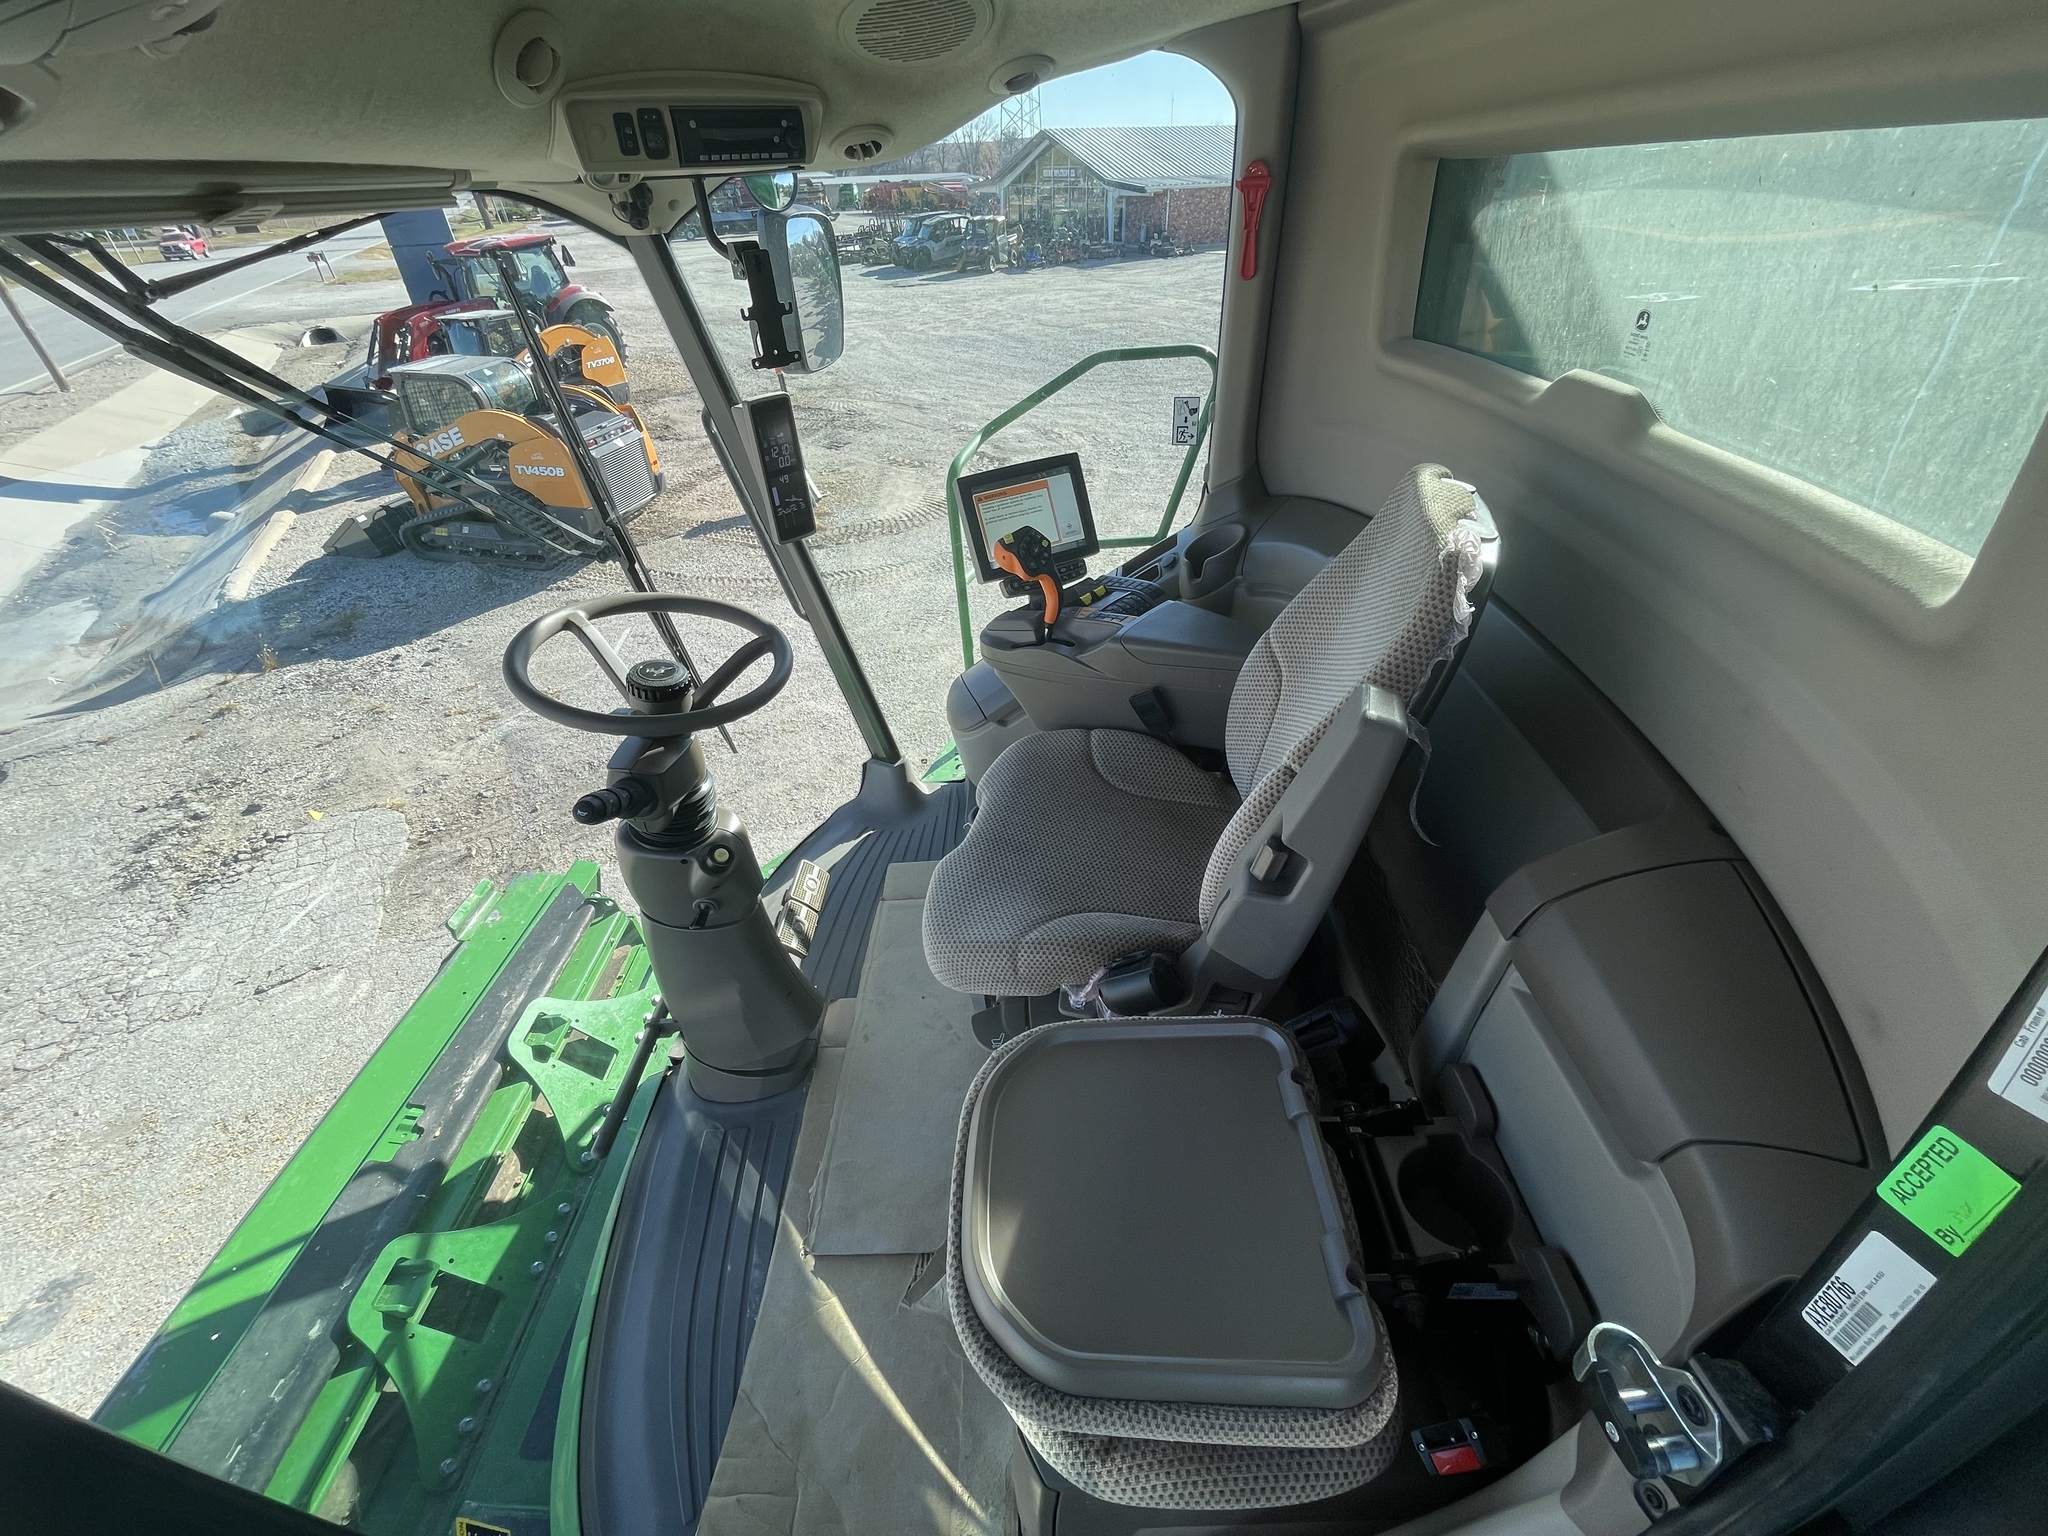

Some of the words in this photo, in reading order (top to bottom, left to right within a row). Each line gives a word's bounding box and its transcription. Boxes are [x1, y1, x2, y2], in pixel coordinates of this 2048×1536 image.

[586, 356, 615, 369] TV370B
[416, 426, 465, 457] CASE
[514, 464, 565, 477] TV450B
[2014, 1035, 2030, 1048] Cab
[1889, 1136, 1960, 1206] ACCEPTED
[1804, 1275, 1856, 1331] AXE80766
